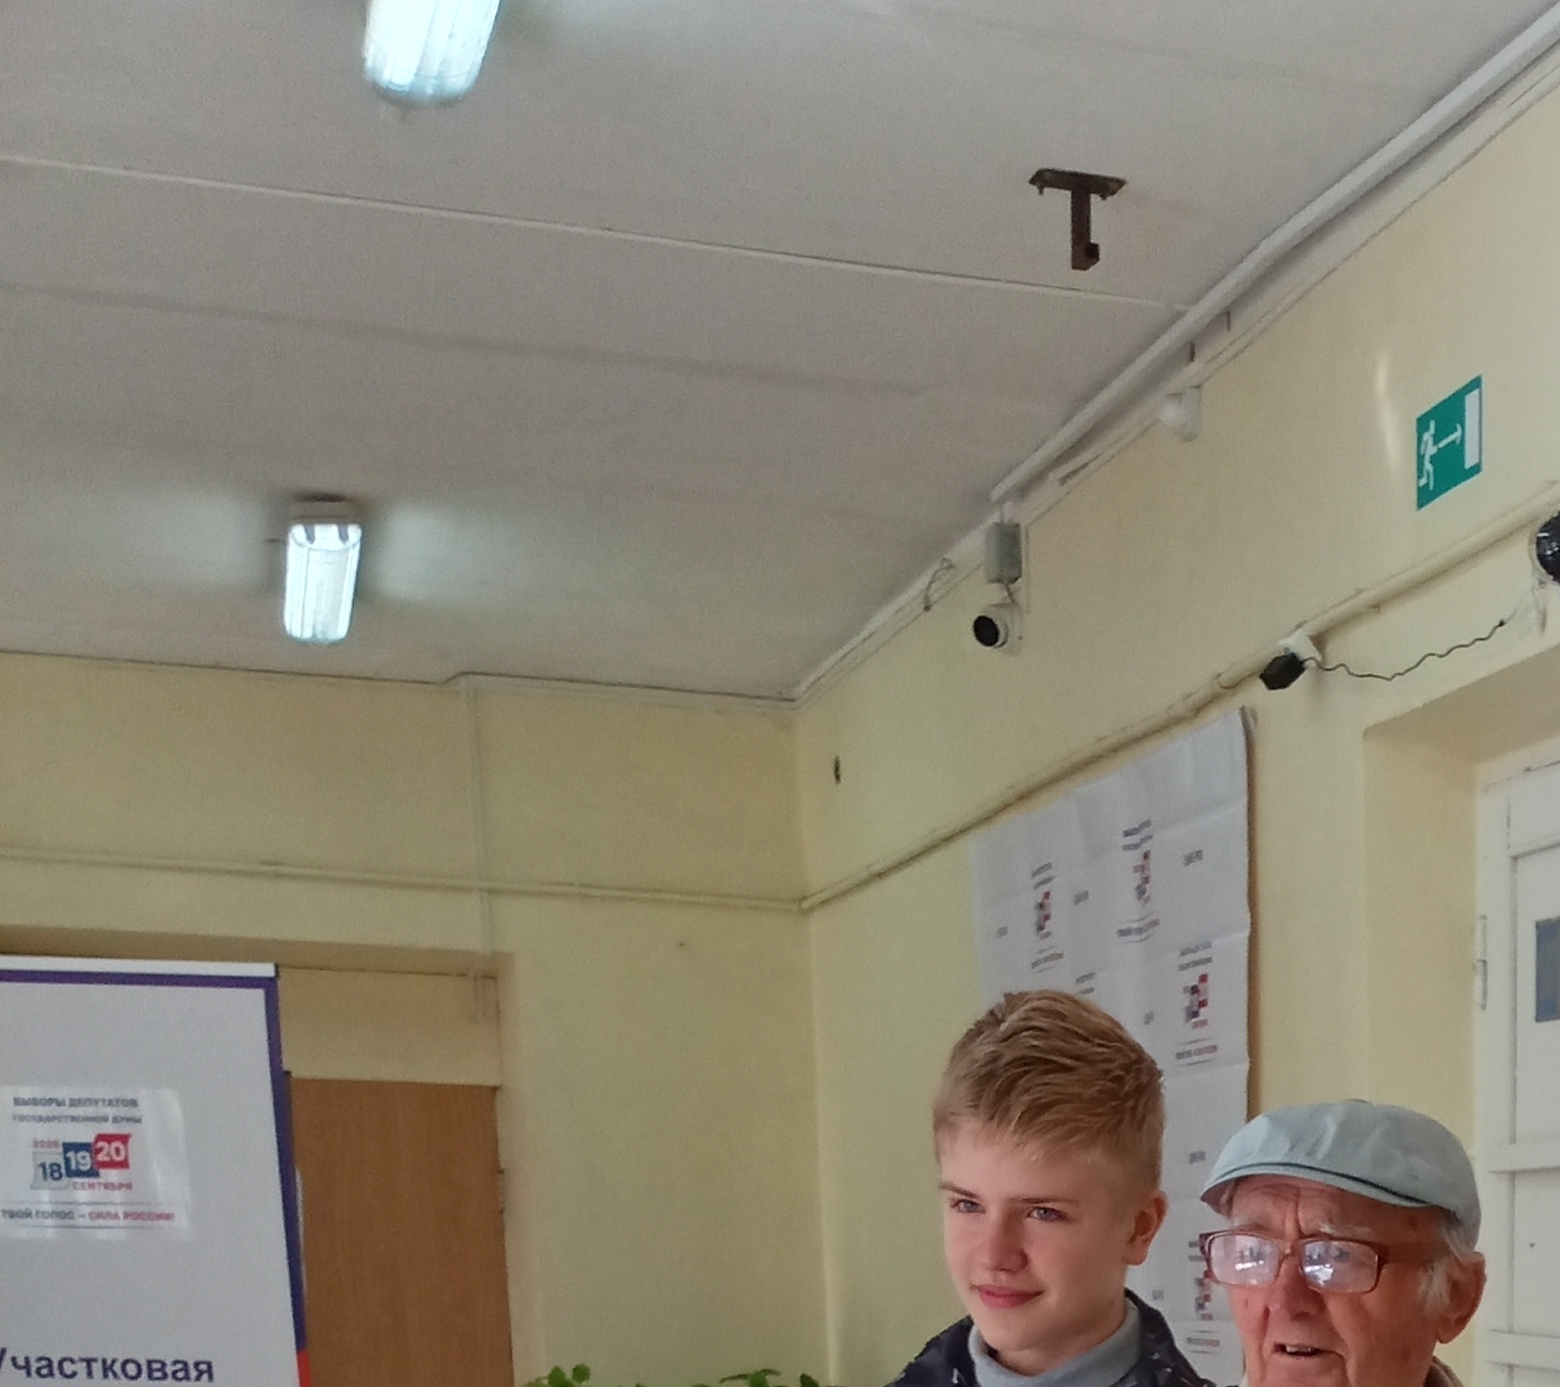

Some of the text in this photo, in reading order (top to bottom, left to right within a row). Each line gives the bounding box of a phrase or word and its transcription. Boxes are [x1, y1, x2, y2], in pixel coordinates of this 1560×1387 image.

[37, 1140, 127, 1182] 18 19 20
